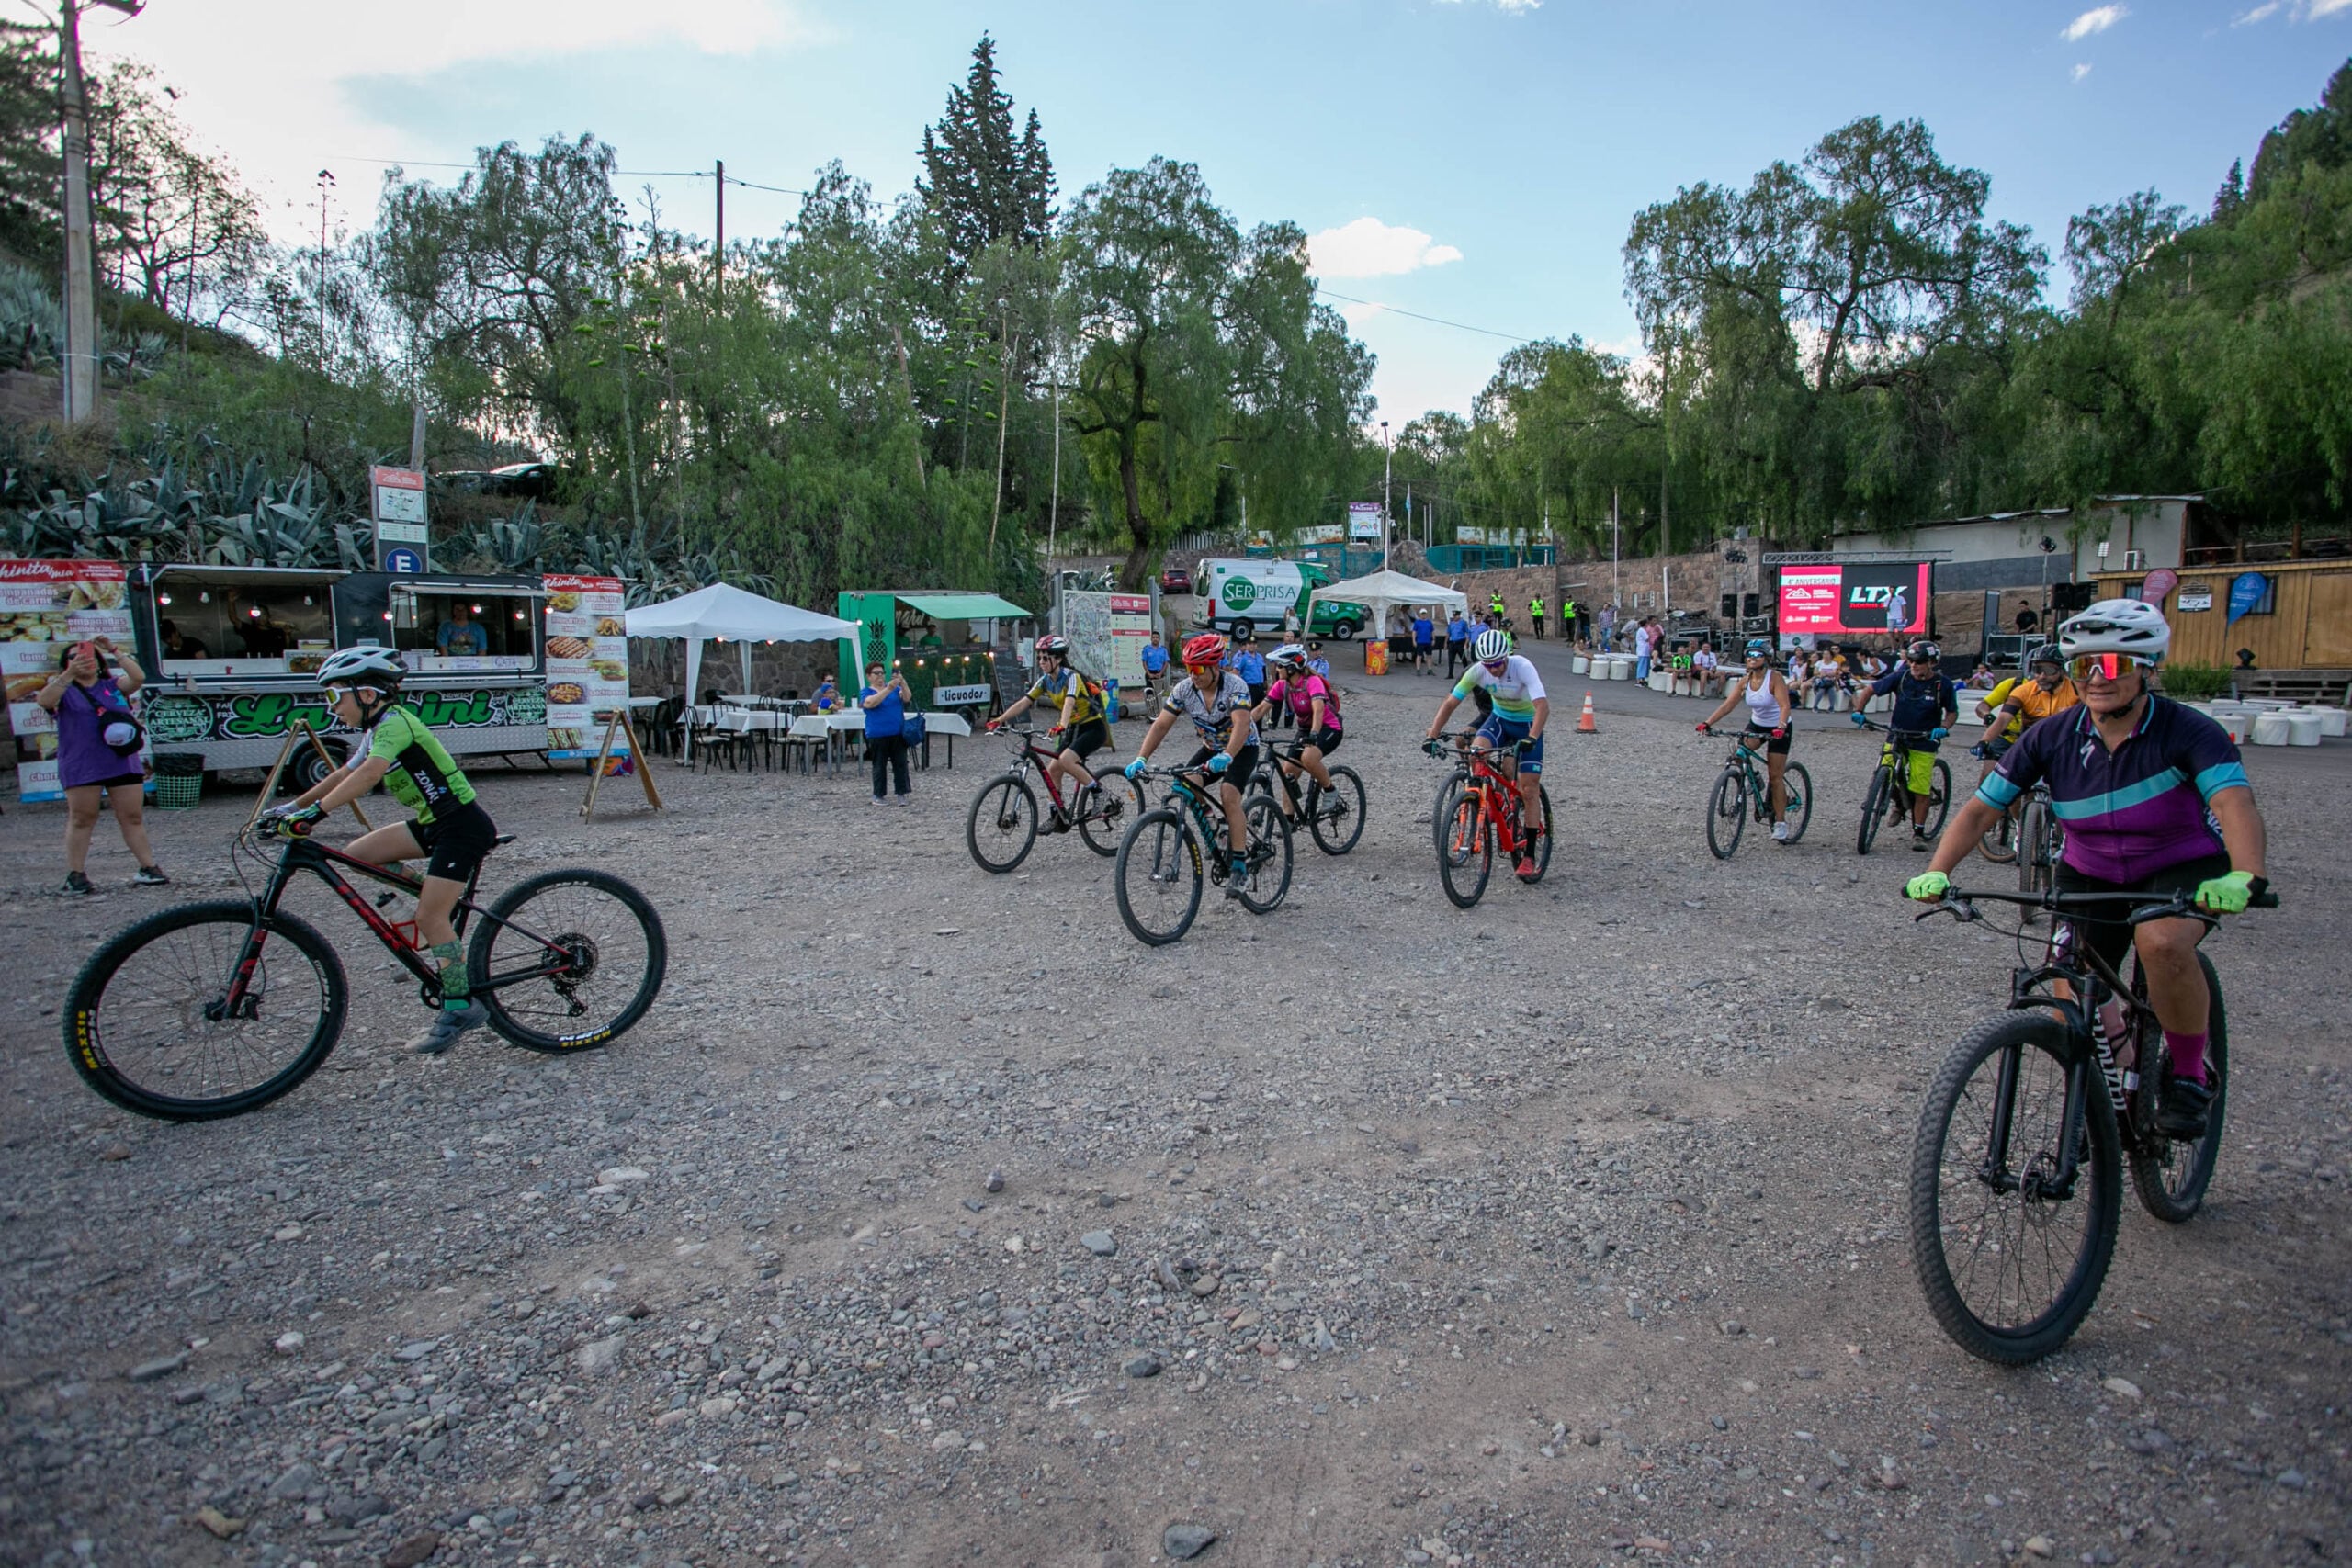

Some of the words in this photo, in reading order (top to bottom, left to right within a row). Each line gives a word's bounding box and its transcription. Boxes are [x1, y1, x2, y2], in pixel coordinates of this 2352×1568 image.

[0, 560, 51, 578] hinita
[396, 555, 412, 572] E
[1225, 583, 1295, 602] SERPRISA
[1849, 586, 1908, 603] LTX
[149, 716, 210, 726] ARTESANAL
[154, 708, 206, 718] CERVEZA
[228, 693, 334, 735] La
[76, 1010, 98, 1069] MAXXIS
[560, 1029, 612, 1047] MAXXIS
